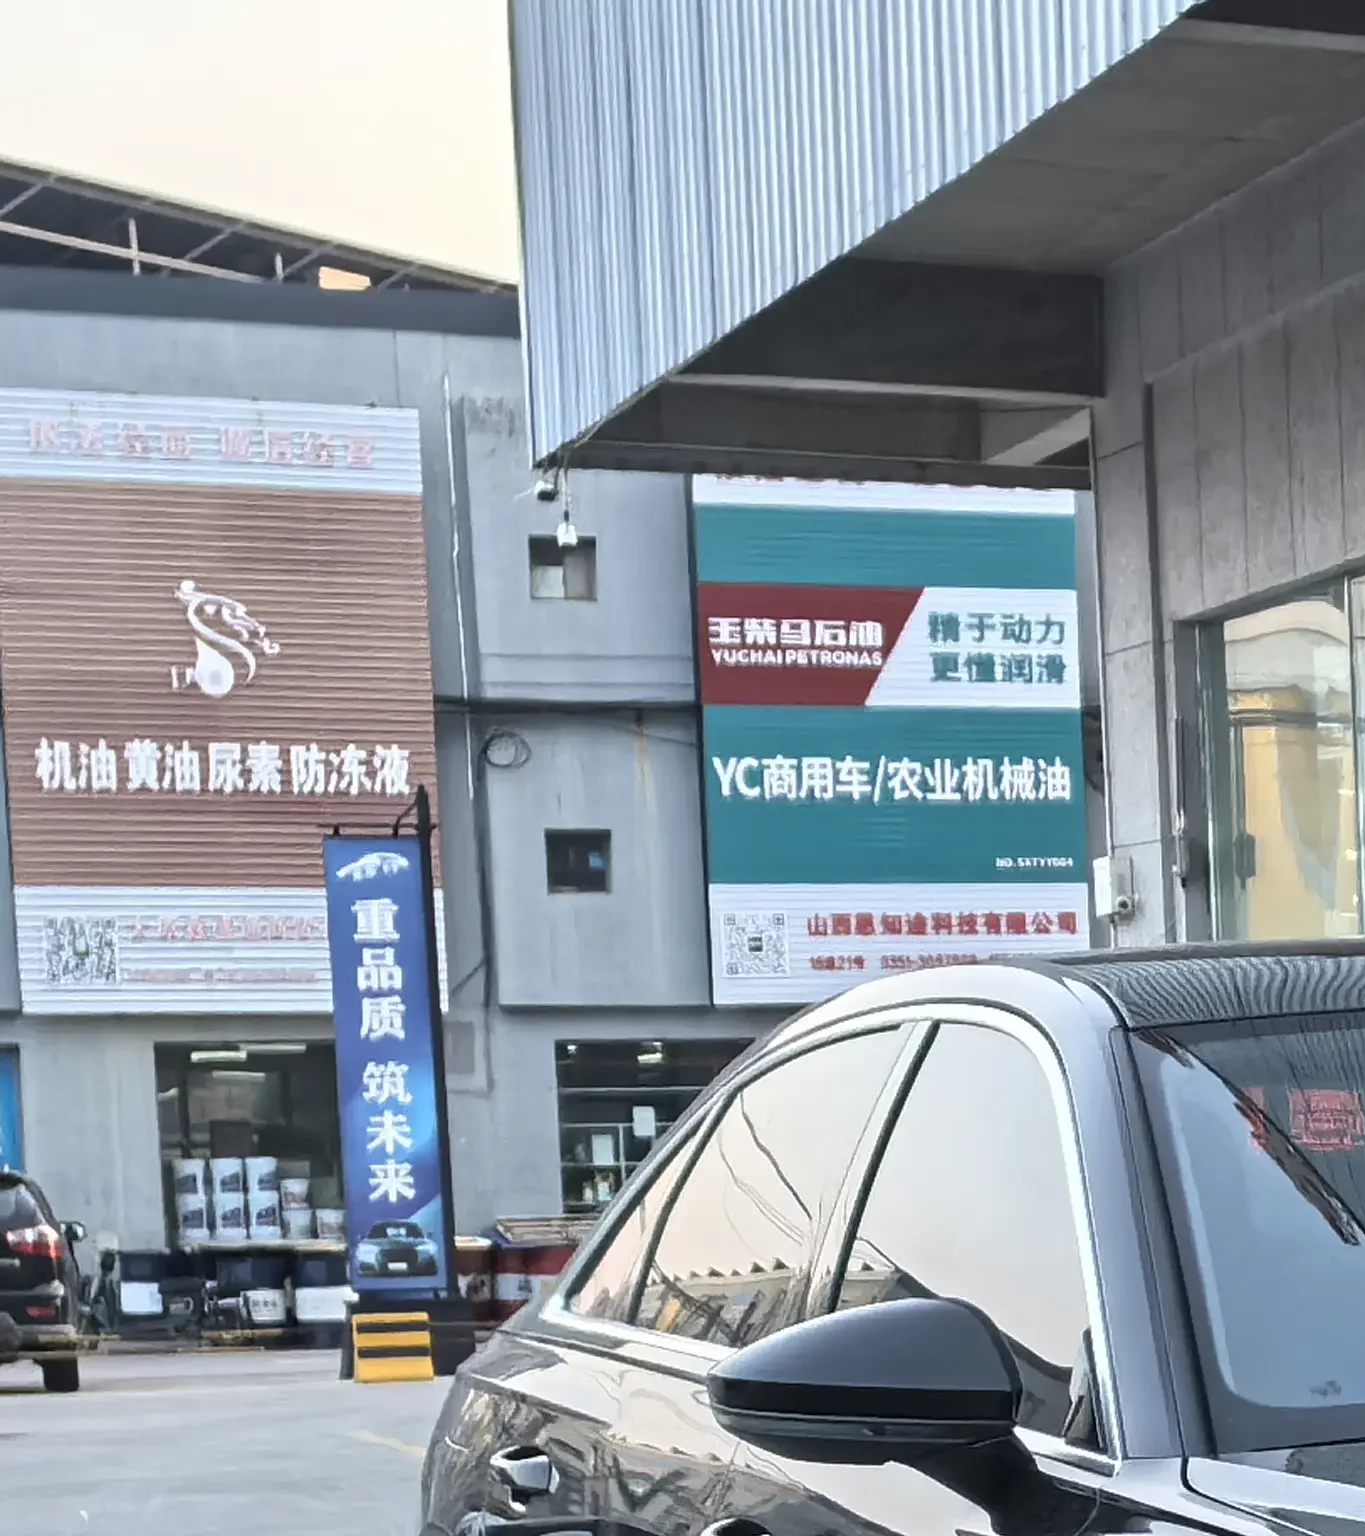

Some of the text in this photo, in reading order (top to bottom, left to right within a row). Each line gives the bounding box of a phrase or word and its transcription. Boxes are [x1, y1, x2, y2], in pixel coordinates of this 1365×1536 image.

[928, 611, 1065, 644] 精于动力
[711, 649, 883, 667] YUCHAI PETRONAS
[930, 651, 1066, 685] 更懂润滑
[351, 898, 417, 1204] 重品质 筑未来
